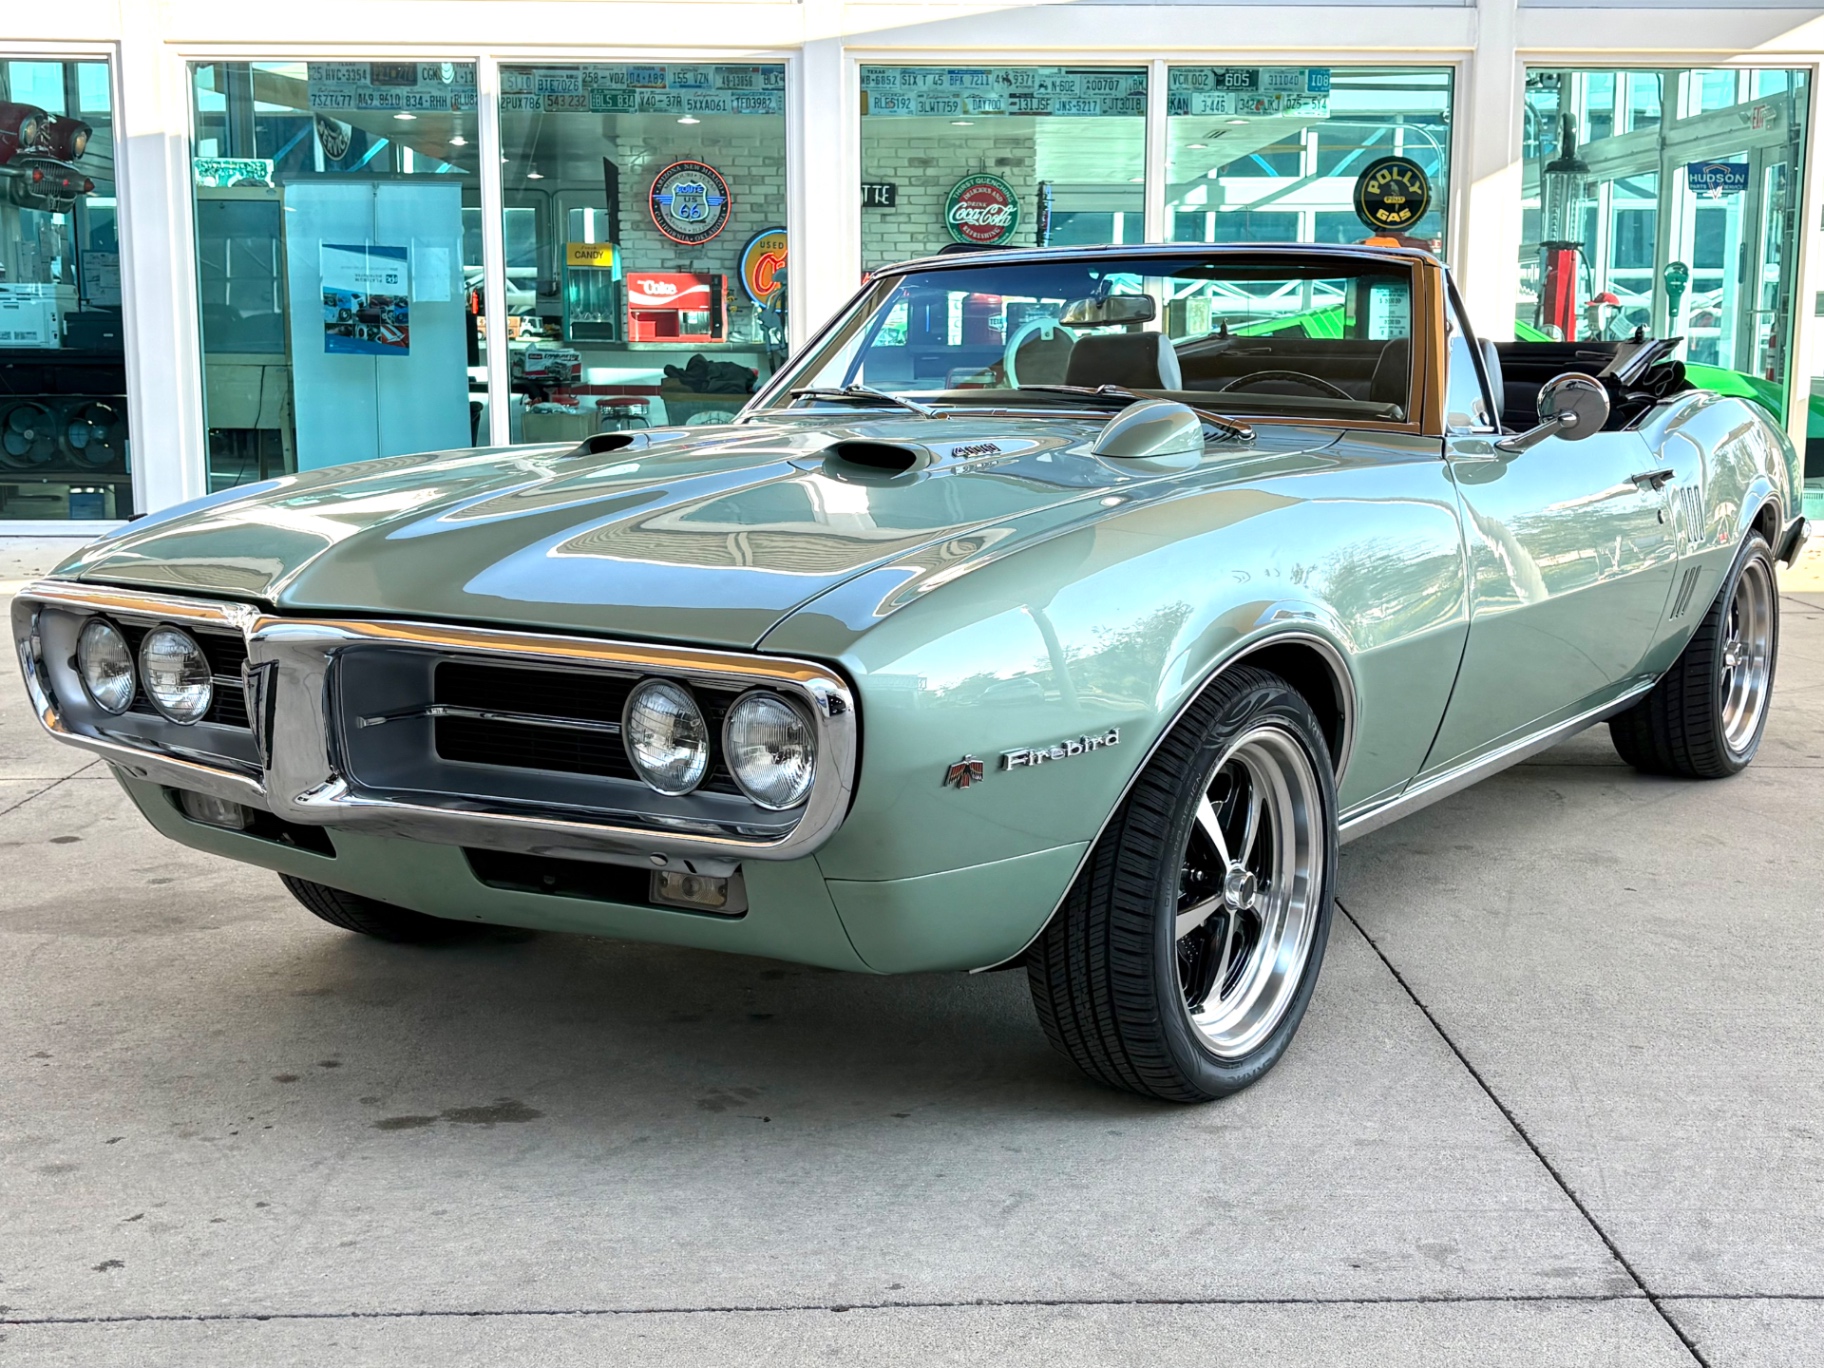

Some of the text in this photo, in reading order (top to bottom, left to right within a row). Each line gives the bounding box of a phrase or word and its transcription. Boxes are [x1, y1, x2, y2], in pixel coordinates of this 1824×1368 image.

[1225, 74, 1250, 86] 605
[701, 167, 724, 190] MEXICO
[1367, 166, 1422, 194] POLLY
[1690, 173, 1745, 184] HUDSON
[953, 178, 1014, 203] THIRST QUENCHING
[679, 203, 702, 219] 66
[948, 202, 1017, 227] Coca-Cola
[1376, 208, 1412, 222] GAS
[760, 241, 784, 250] USED
[574, 250, 605, 260] CANDY
[1001, 727, 1121, 772] Firebird
